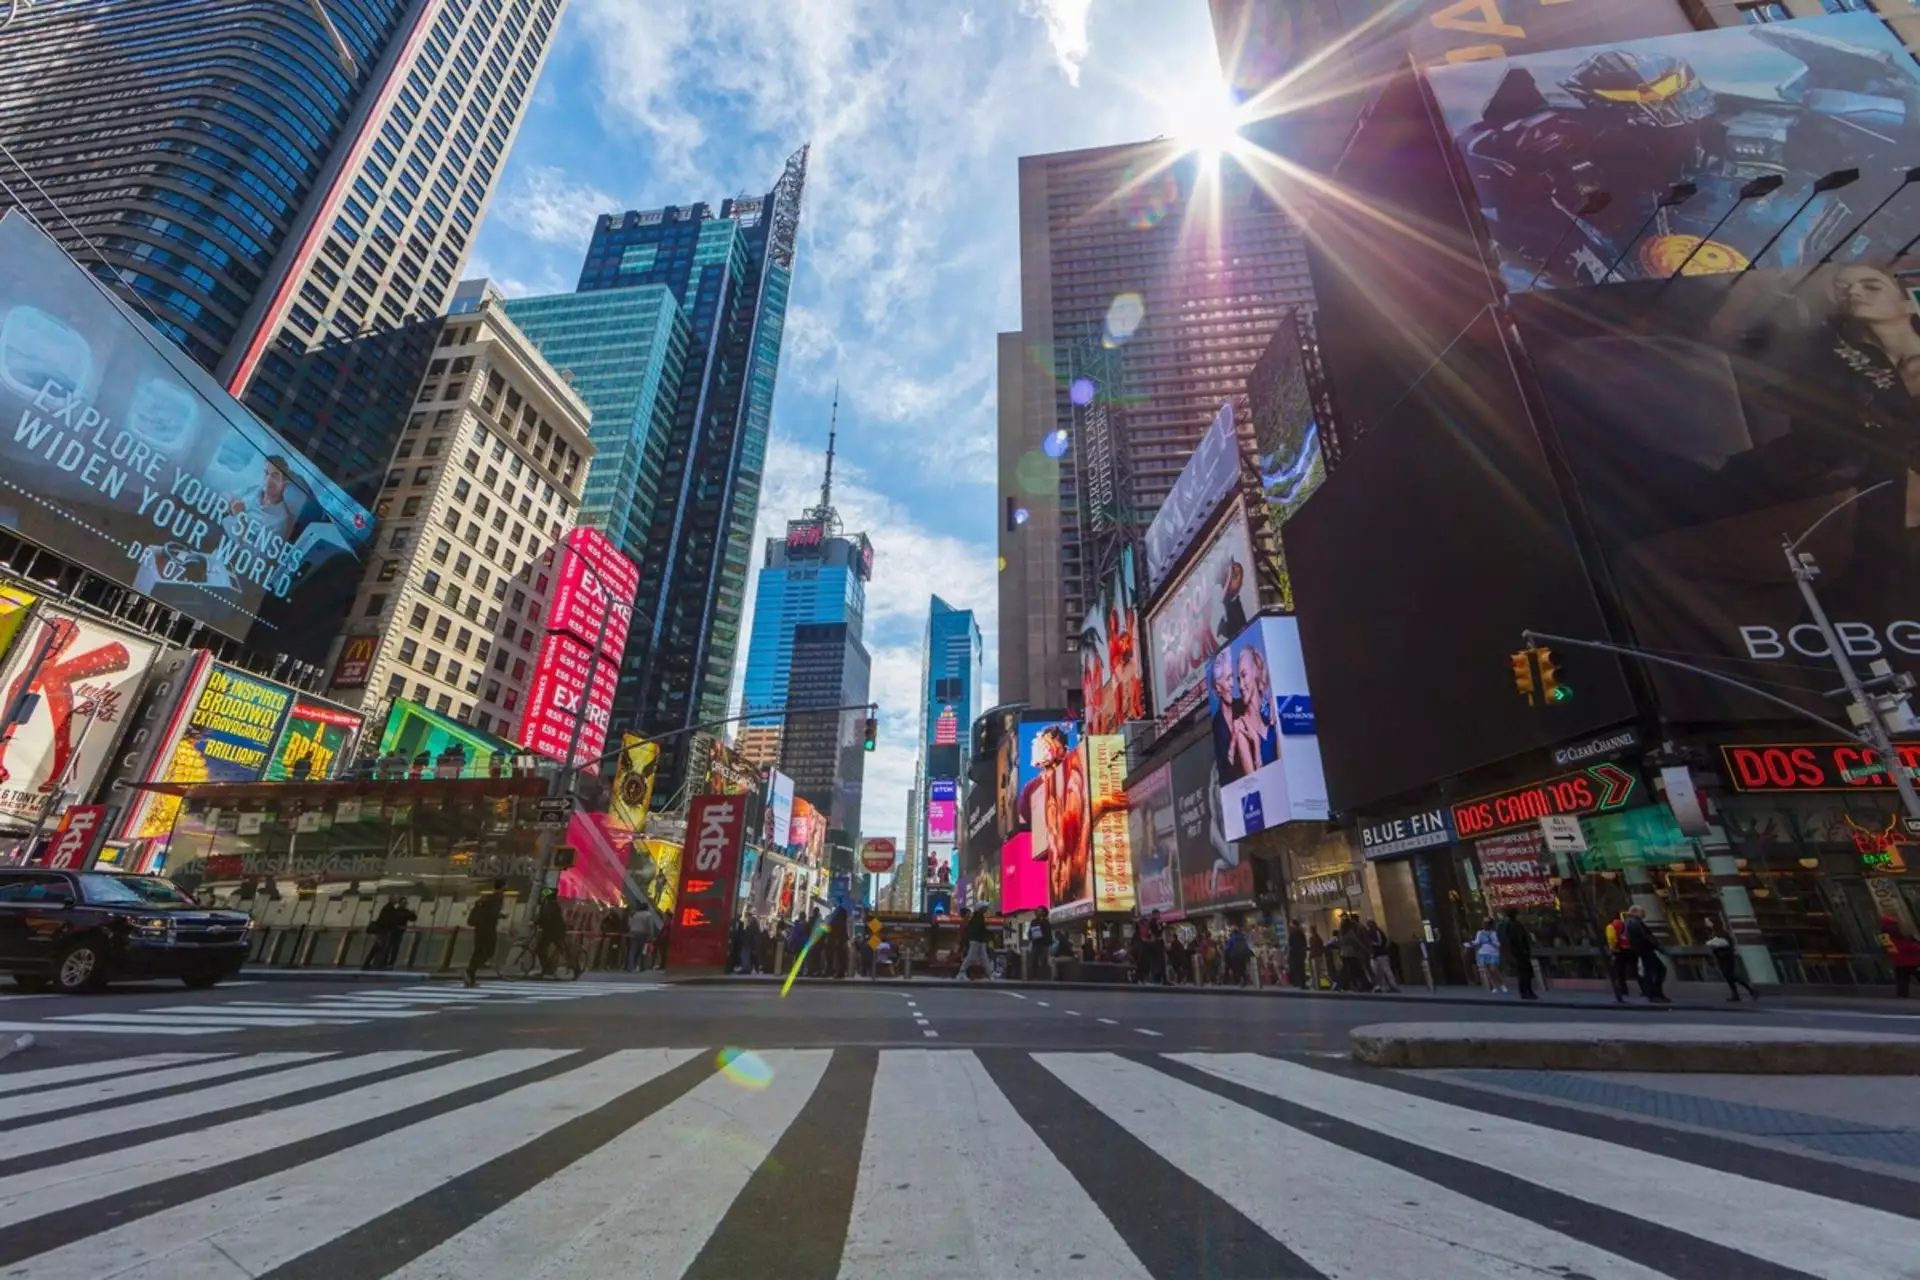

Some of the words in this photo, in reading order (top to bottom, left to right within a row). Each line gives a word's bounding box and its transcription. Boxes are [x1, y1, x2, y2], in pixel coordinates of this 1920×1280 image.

[33, 379, 167, 482] EXPLORE
[172, 466, 231, 525] YOUR
[13, 409, 128, 500] WIDEN
[137, 483, 209, 550] YOUR
[199, 688, 281, 730] BROADWAY
[207, 671, 232, 693] AN
[230, 679, 288, 712] INSPIRED
[1734, 748, 1825, 787] DOS
[696, 801, 736, 872] tkts
[1362, 820, 1406, 847] BLUE
[1410, 809, 1443, 836] FIN
[1456, 804, 1494, 835] DOS
